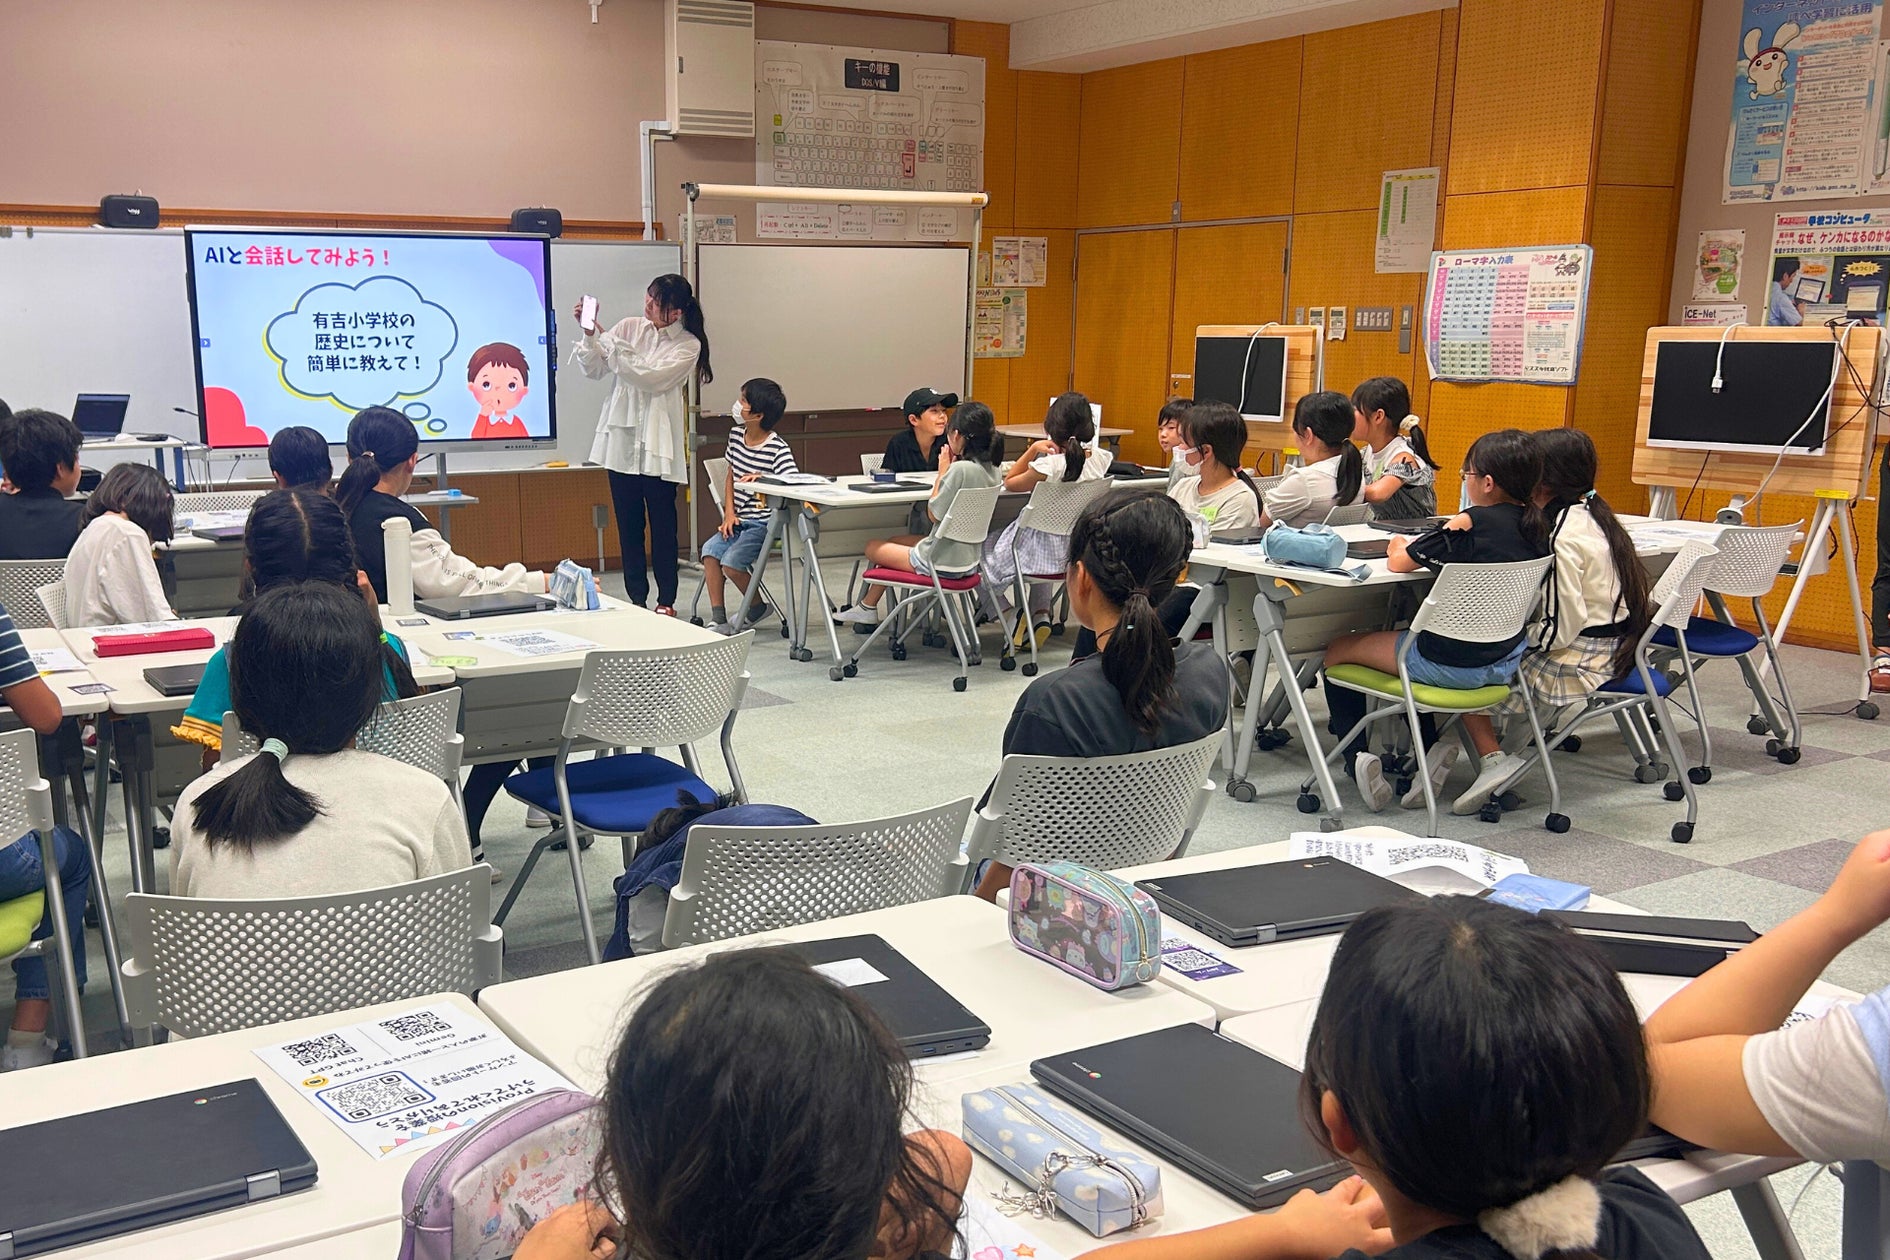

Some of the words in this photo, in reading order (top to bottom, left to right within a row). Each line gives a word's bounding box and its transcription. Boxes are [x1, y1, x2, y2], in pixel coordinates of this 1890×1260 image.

[855, 61, 891, 75] キーの機能
[204, 245, 391, 267] AIと会話してみよう！
[1455, 254, 1514, 266] ローマ字入力表
[312, 311, 415, 330] 有吉小学校の
[315, 333, 415, 351] 歴史について
[307, 355, 421, 373] 簡単に教えて！
[376, 1079, 536, 1129] うけてくれてありがとう
